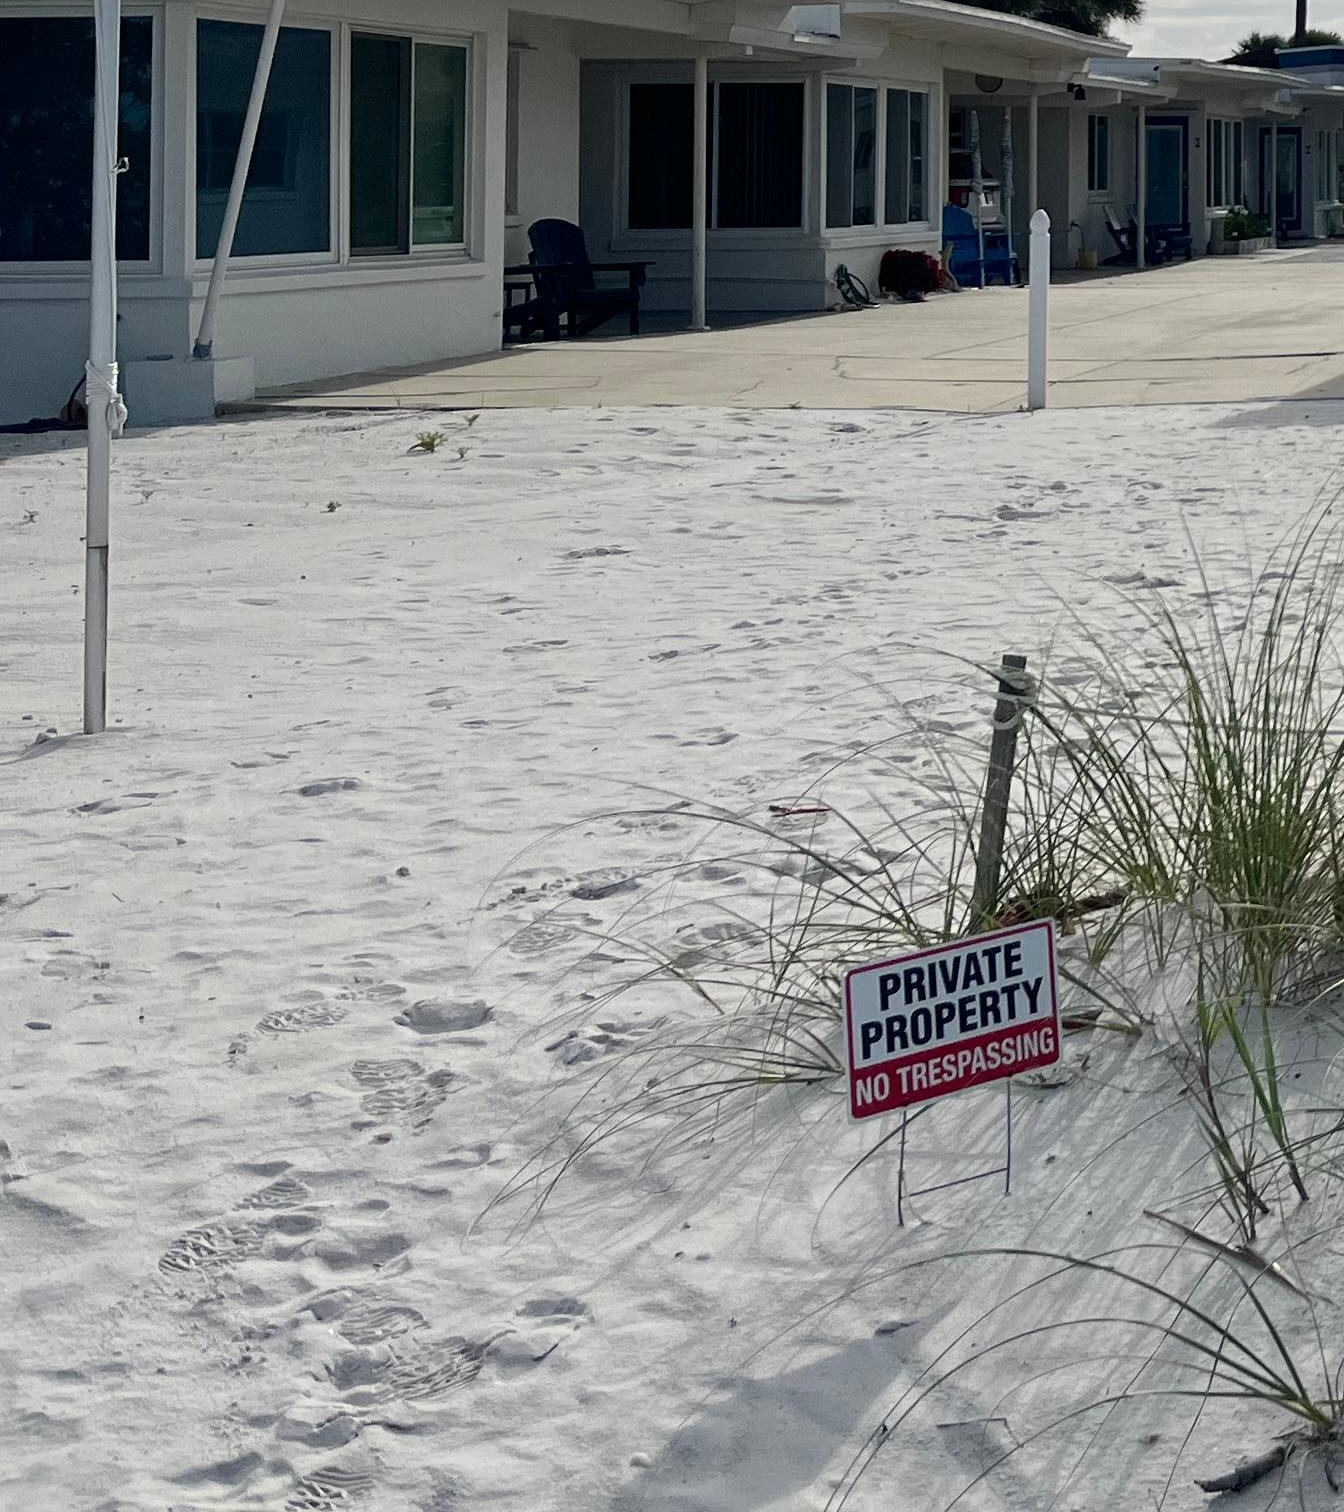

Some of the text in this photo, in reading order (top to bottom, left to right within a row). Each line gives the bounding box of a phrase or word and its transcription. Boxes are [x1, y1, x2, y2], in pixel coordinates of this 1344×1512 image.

[879, 940, 1023, 1012] PRIVATE
[860, 976, 1044, 1061] PROPERTY
[855, 1026, 1055, 1107] NO TRESPASSING
